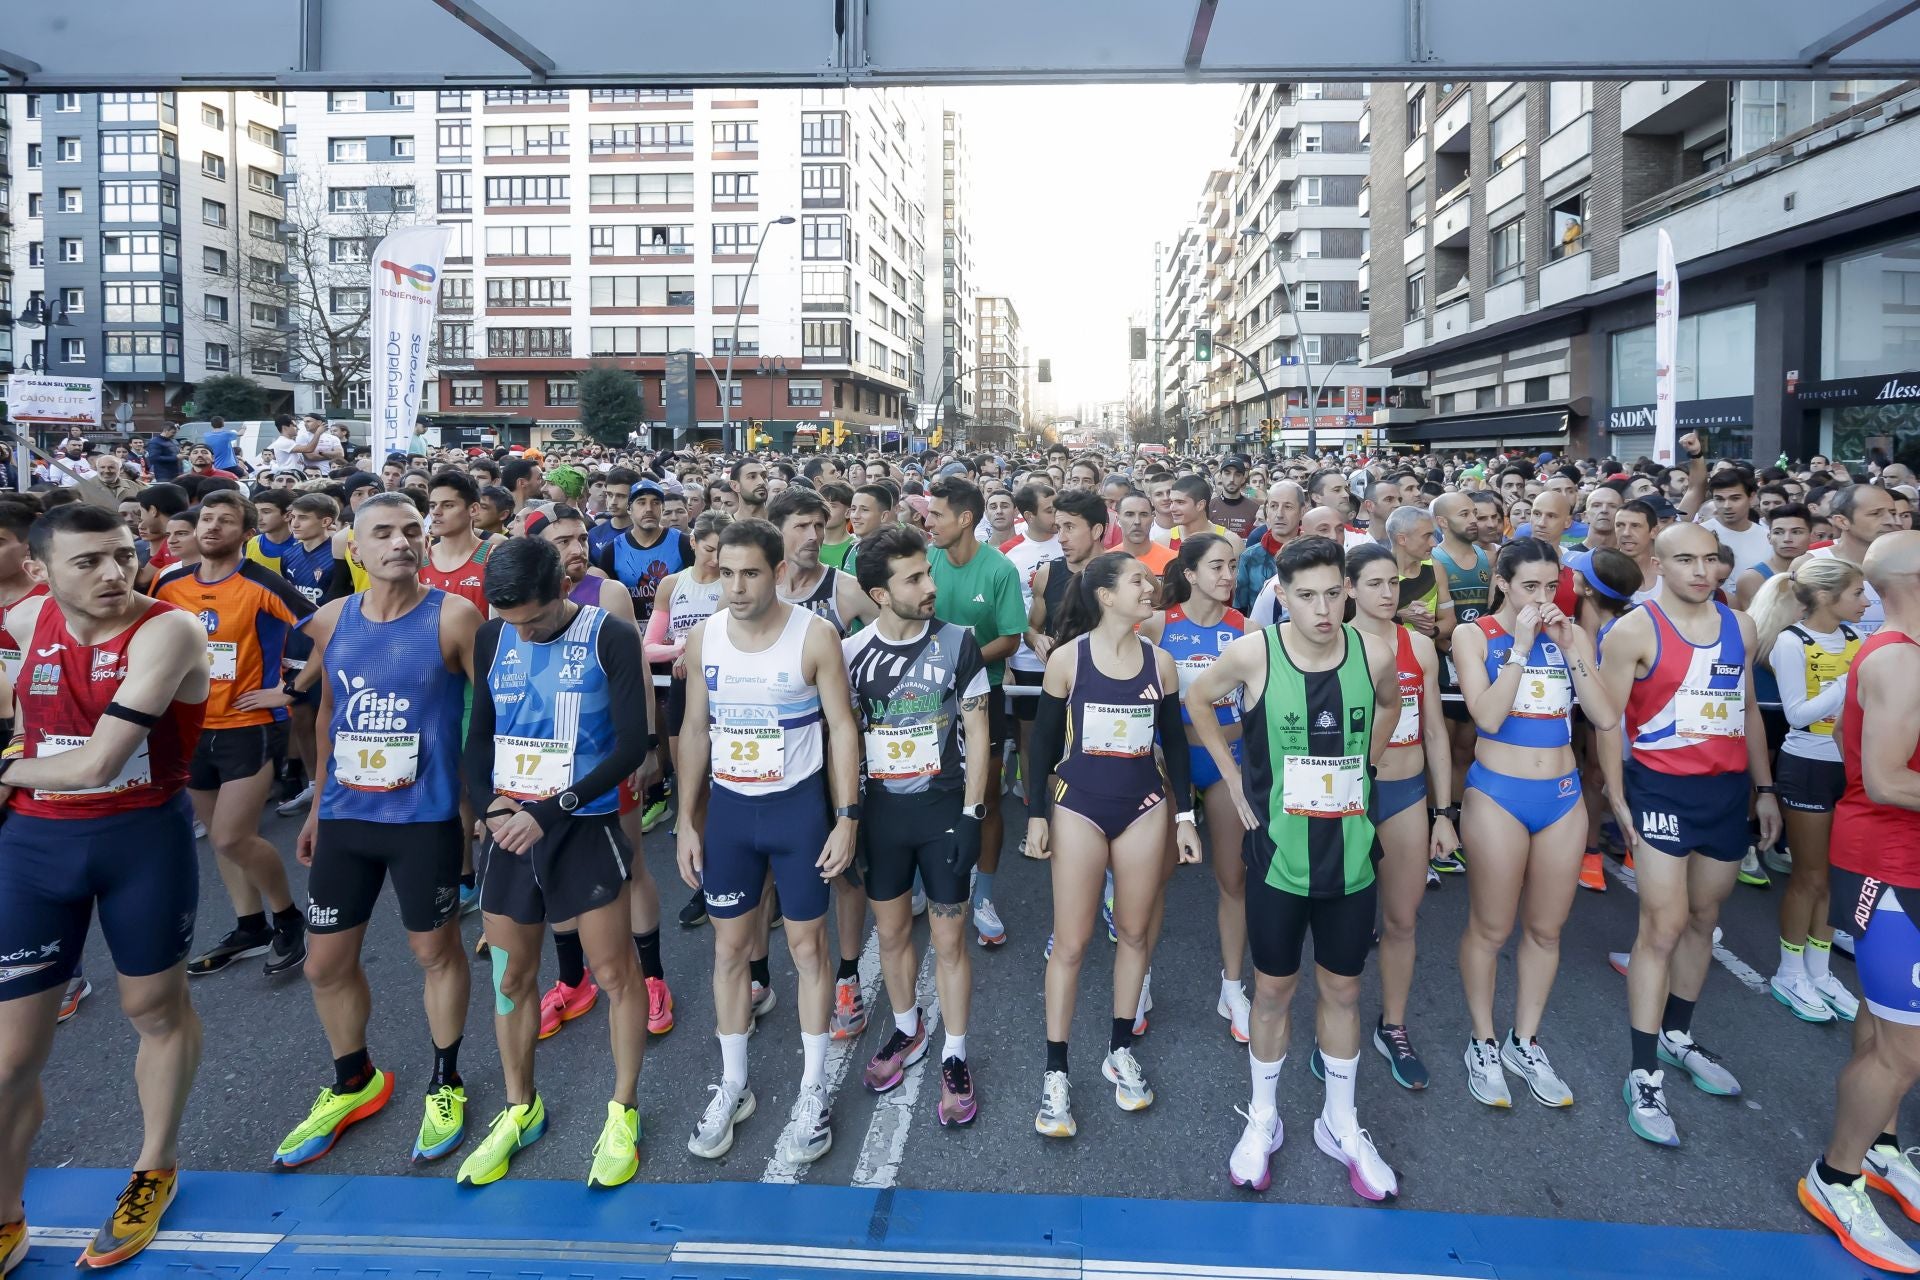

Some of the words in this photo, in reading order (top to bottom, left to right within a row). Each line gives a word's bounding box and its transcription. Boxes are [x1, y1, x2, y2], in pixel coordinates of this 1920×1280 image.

[380, 289, 432, 305] TotalEnergie
[1704, 416, 1743, 424] DENTAL
[887, 681, 931, 698] RESTAURANTE
[1530, 680, 1546, 699] 3
[359, 692, 410, 712] Fisio
[1700, 702, 1728, 720] 44
[357, 711, 408, 731] Fisio
[899, 725, 933, 736] SILVESTRE
[1113, 719, 1127, 738] 2
[55, 738, 66, 746] 55
[507, 738, 515, 746] 55
[529, 740, 569, 748] SILVESTRE
[730, 741, 760, 761] 23
[887, 740, 916, 760] 39
[357, 749, 387, 769] 16
[515, 753, 542, 776] 17
[1327, 757, 1360, 766] SILVESTRE
[1321, 773, 1333, 794] 1
[1642, 811, 1680, 836] MAG
[1854, 876, 1881, 931] ADIZER
